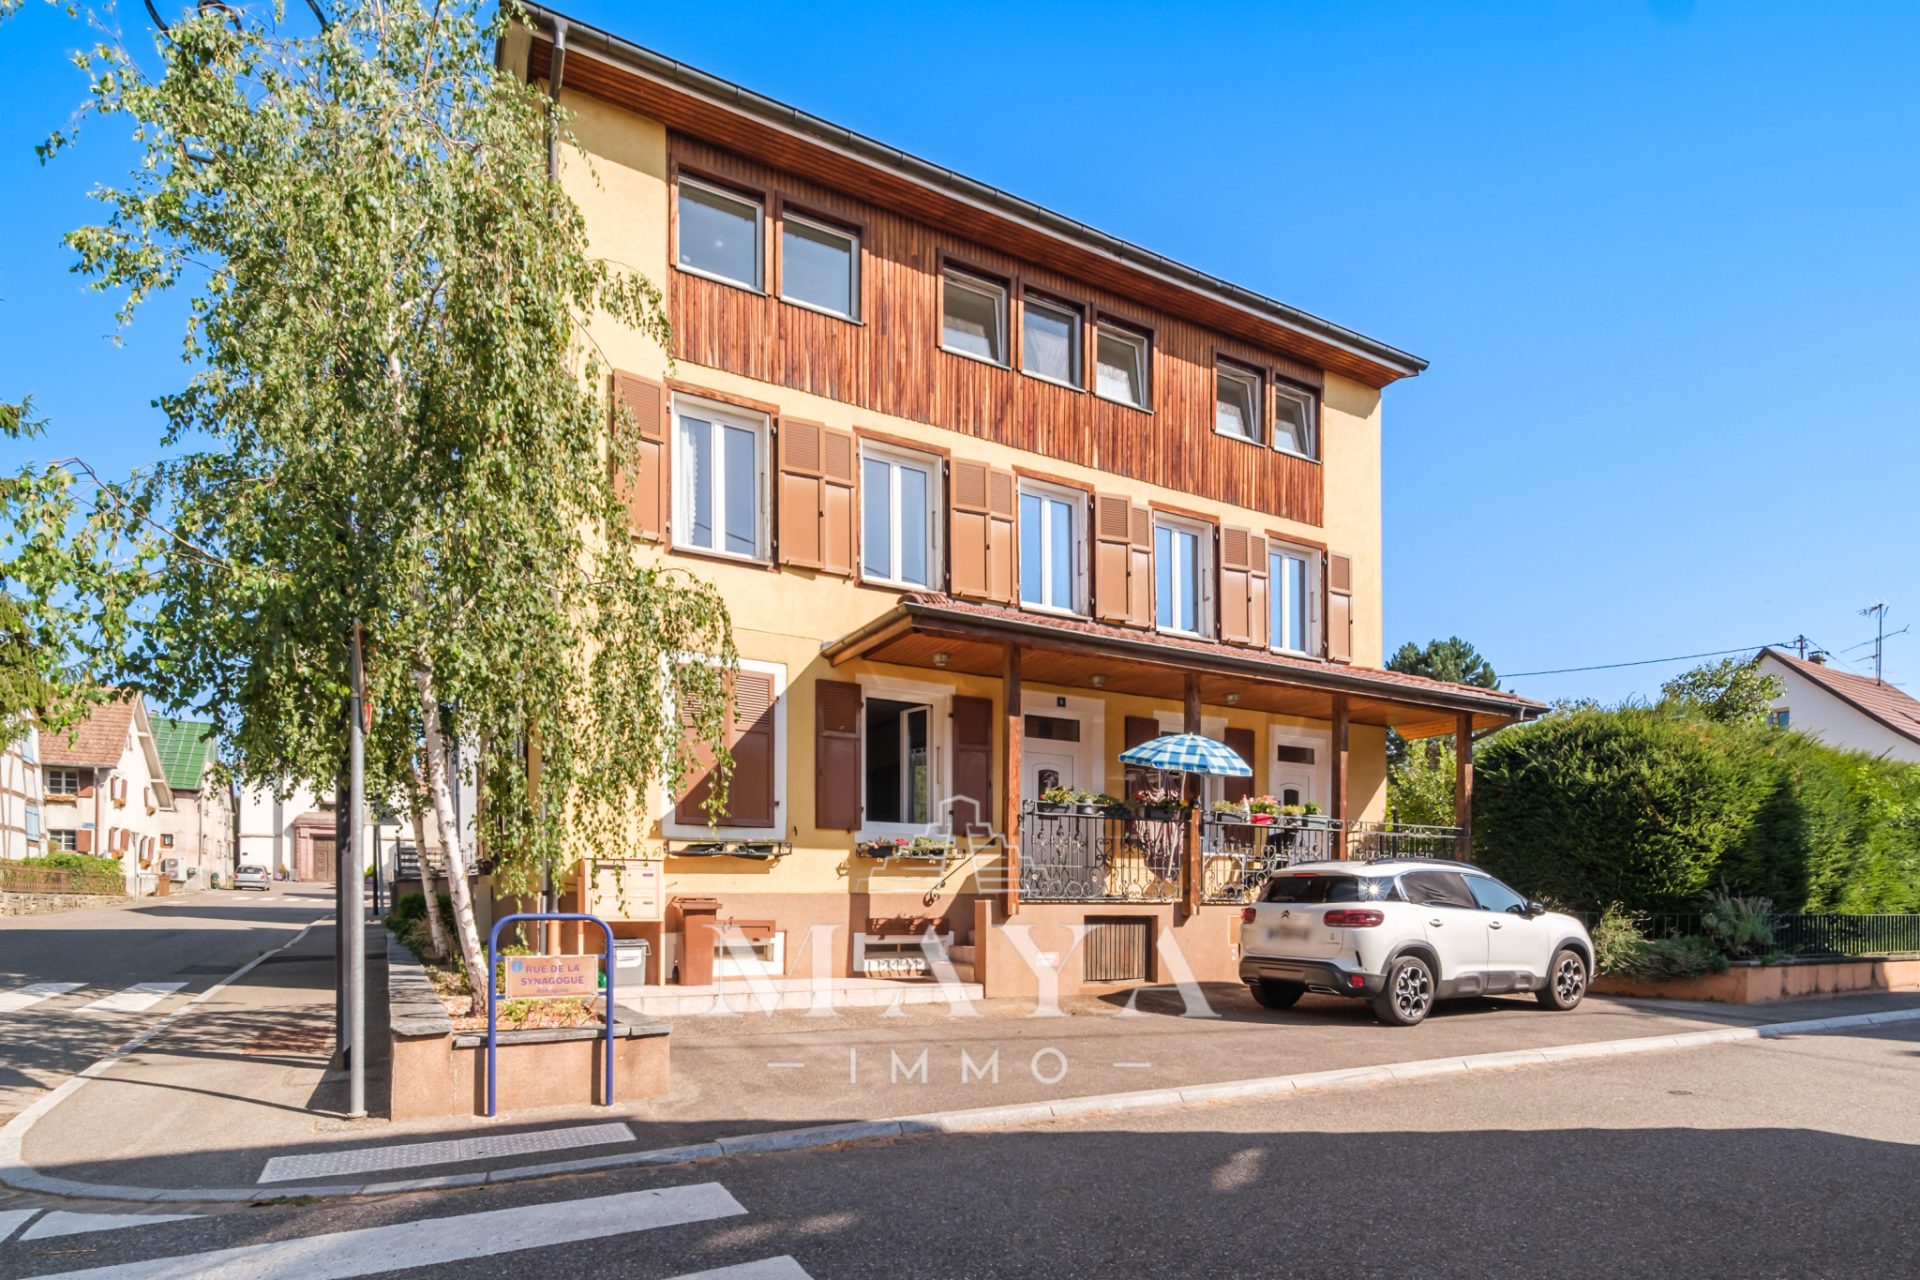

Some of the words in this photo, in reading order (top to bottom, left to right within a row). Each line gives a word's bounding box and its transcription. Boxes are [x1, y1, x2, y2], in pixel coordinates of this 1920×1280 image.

[525, 965, 547, 973] RUE
[550, 964, 564, 973] DE
[567, 964, 580, 972] LA
[520, 975, 584, 985] SYNAGOGUE
